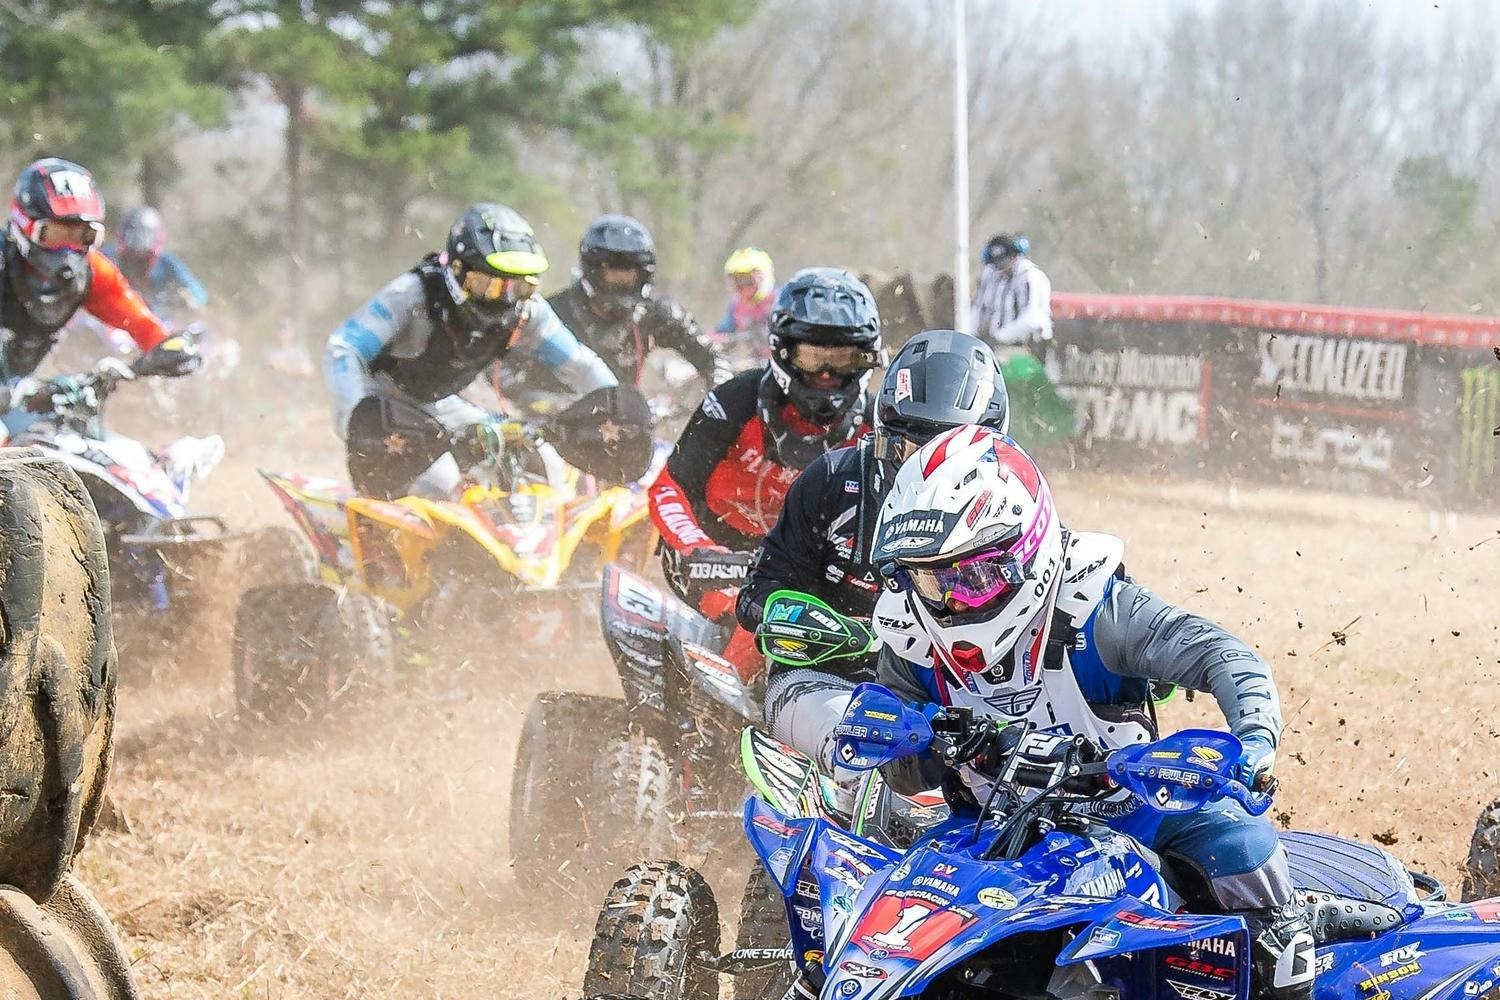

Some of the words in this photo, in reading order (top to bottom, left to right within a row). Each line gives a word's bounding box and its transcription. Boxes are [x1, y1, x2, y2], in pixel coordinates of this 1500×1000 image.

[894, 518, 944, 534] YAMAHA
[877, 615, 916, 631] FLY
[1158, 768, 1200, 785] FOWLER
[922, 877, 961, 897] YAMAHA
[1080, 868, 1127, 898] YAMAHA
[801, 909, 823, 923] BN
[873, 903, 932, 947] 1
[761, 949, 794, 959] STAR
[1380, 941, 1428, 968] FOX
[1163, 955, 1237, 981] GBC
[1360, 962, 1423, 993] HINSON
